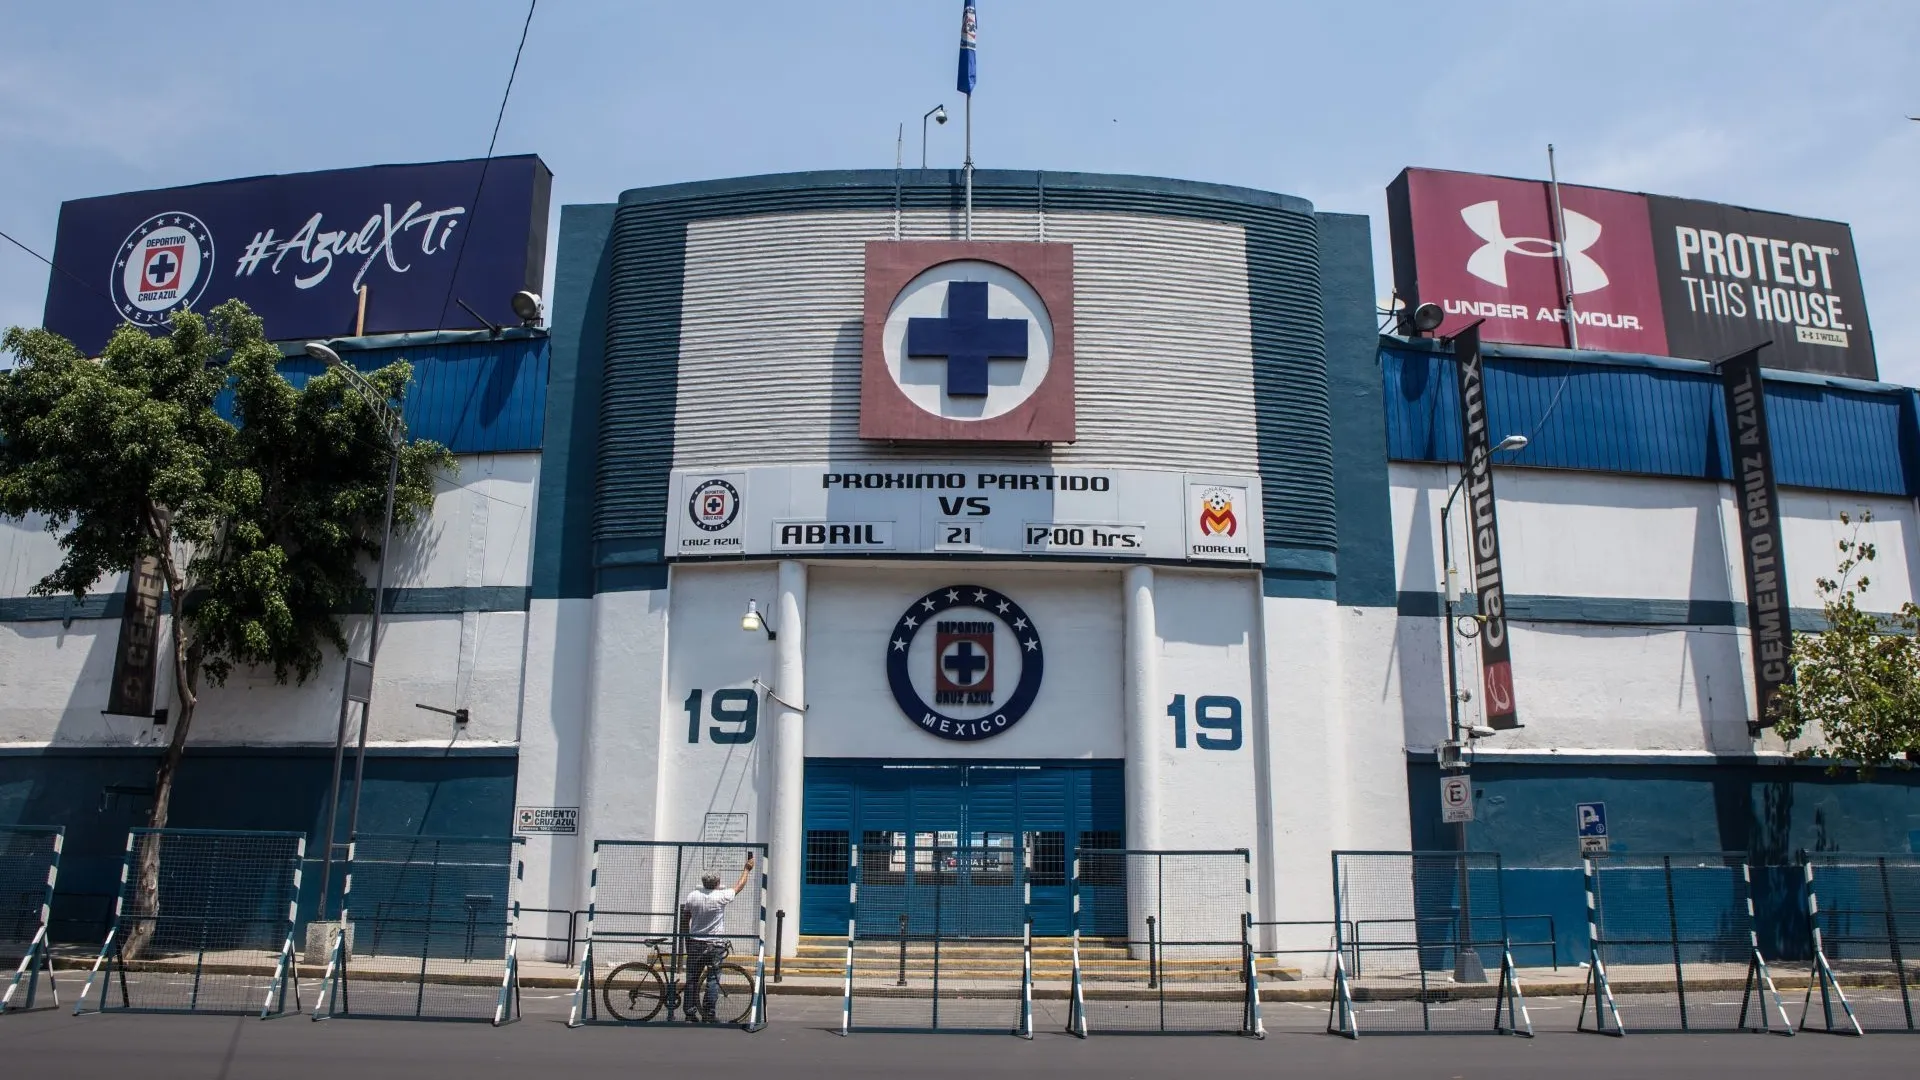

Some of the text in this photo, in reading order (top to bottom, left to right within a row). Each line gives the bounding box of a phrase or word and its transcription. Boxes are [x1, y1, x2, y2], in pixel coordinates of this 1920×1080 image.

[146, 236, 186, 247] DEPORTIVO
[235, 201, 465, 294] #AzulXTi
[138, 290, 177, 302] CRUZ AZUL
[1681, 276, 1852, 330] THIS HOUSE.
[1443, 299, 1529, 319] UNDER
[822, 473, 1110, 491] PROXIMO PARTIDO
[938, 496, 991, 516] VS
[1733, 367, 1785, 682] CEMENTO CRUZ AZUL
[682, 536, 743, 546] CRUZ AZUL
[781, 524, 884, 545] ABRIL
[947, 527, 971, 544] 21
[1026, 527, 1142, 548] 17:00 hrs.
[1193, 544, 1247, 555] MORELIA
[937, 621, 995, 634] DEPORTIVO
[935, 691, 994, 705] CRUZ AZUL
[684, 688, 759, 744] 19
[922, 713, 1007, 736] MEXICO
[1166, 693, 1243, 751] 19
[534, 809, 577, 818] CEMENTO
[534, 818, 576, 827] CRUZ AZUL
